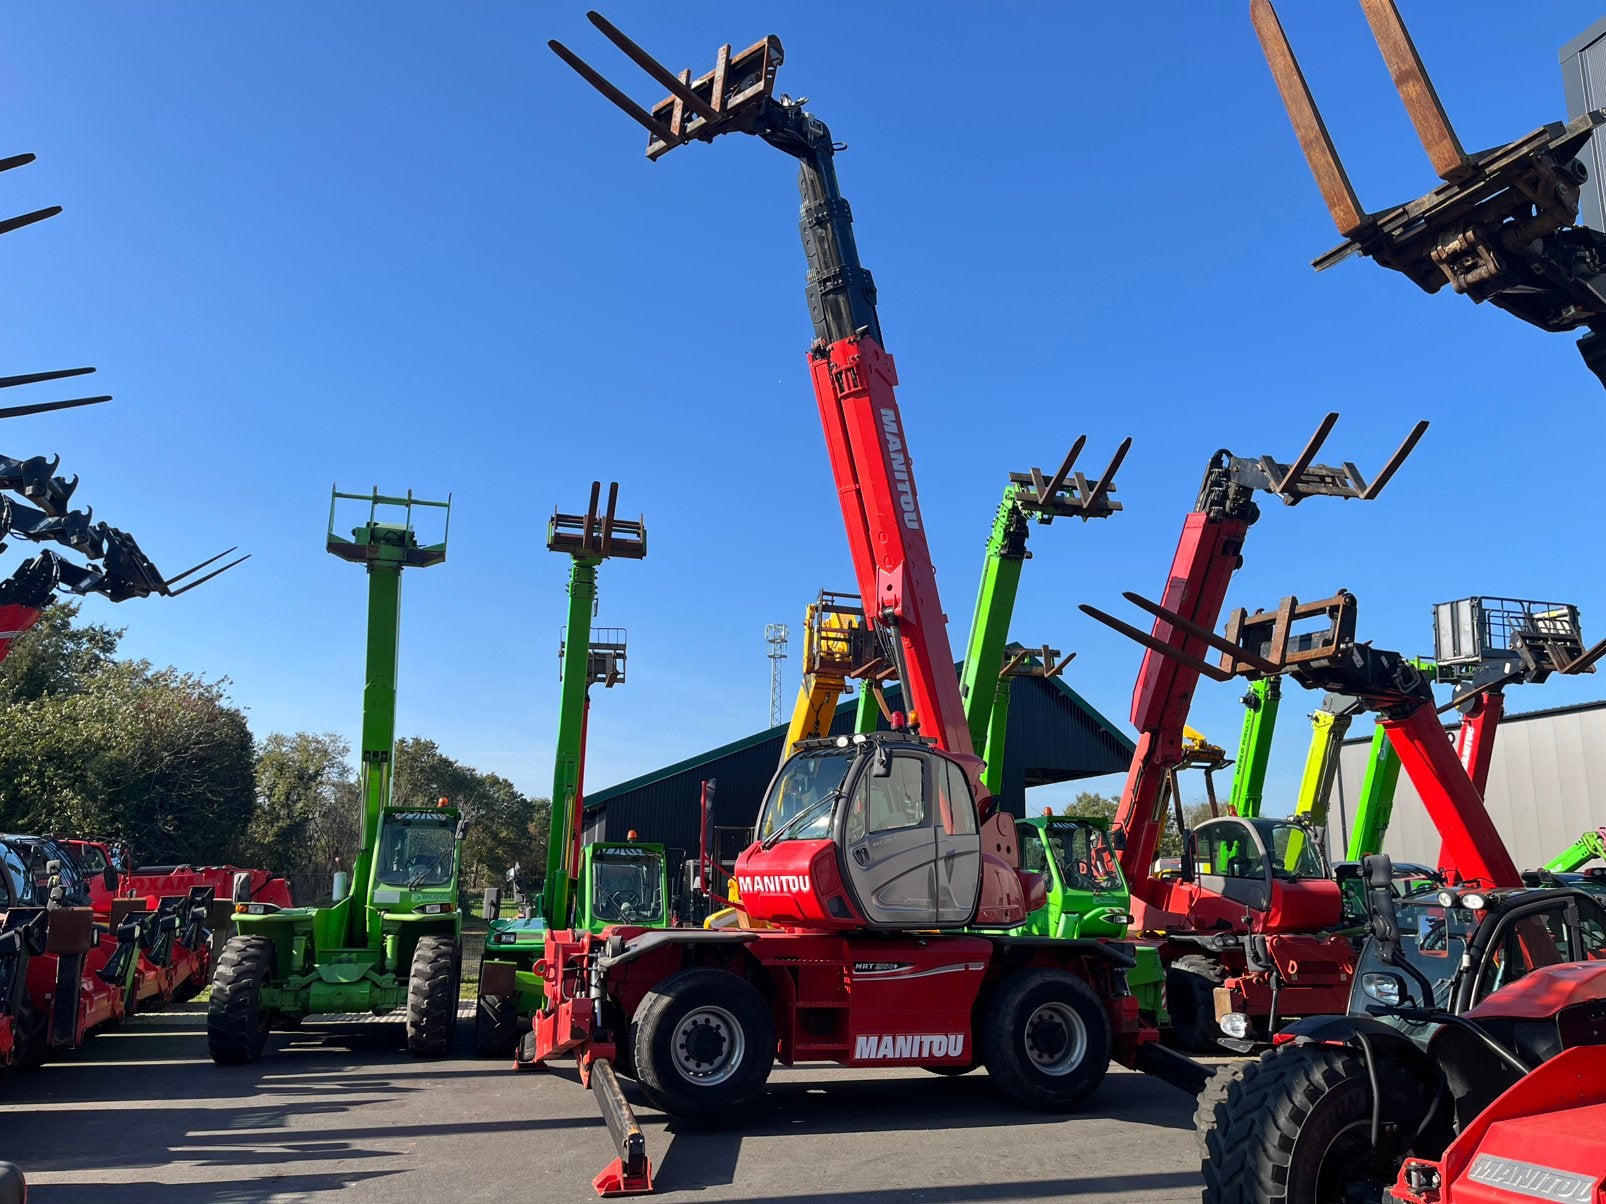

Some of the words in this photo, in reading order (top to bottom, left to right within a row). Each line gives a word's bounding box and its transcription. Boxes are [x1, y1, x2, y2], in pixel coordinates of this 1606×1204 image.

[880, 408, 919, 530] MANITOU
[1236, 748, 1245, 776] MERLO
[738, 875, 810, 893] MANITOU
[854, 1034, 965, 1060] MANITOU
[1471, 1159, 1592, 1202] MANITOU
